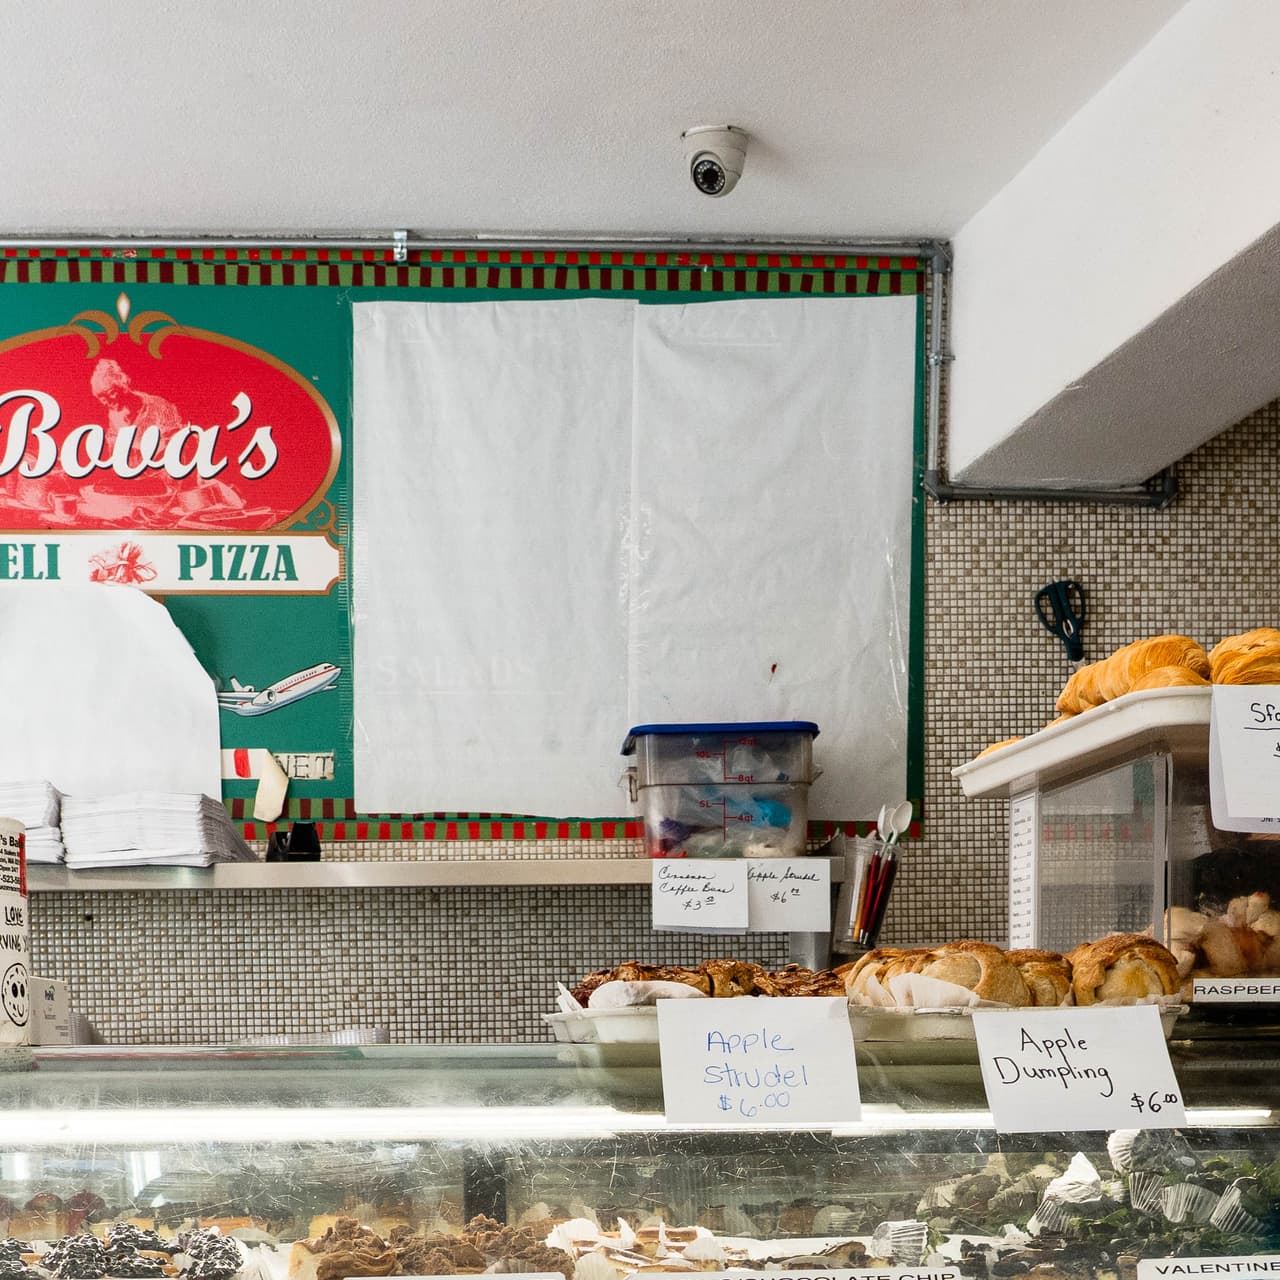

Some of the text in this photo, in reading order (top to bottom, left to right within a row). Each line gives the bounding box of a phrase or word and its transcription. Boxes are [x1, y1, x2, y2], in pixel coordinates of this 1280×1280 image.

[177, 544, 299, 582] PIZZA
[737, 774, 754, 784] 8qt
[737, 814, 754, 823] 4qt
[5, 906, 24, 926] LOVE
[707, 1028, 794, 1053] Apple
[1020, 1028, 1087, 1057] Apple
[703, 1062, 808, 1087] Strudel
[993, 1056, 1114, 1097] Dumpling
